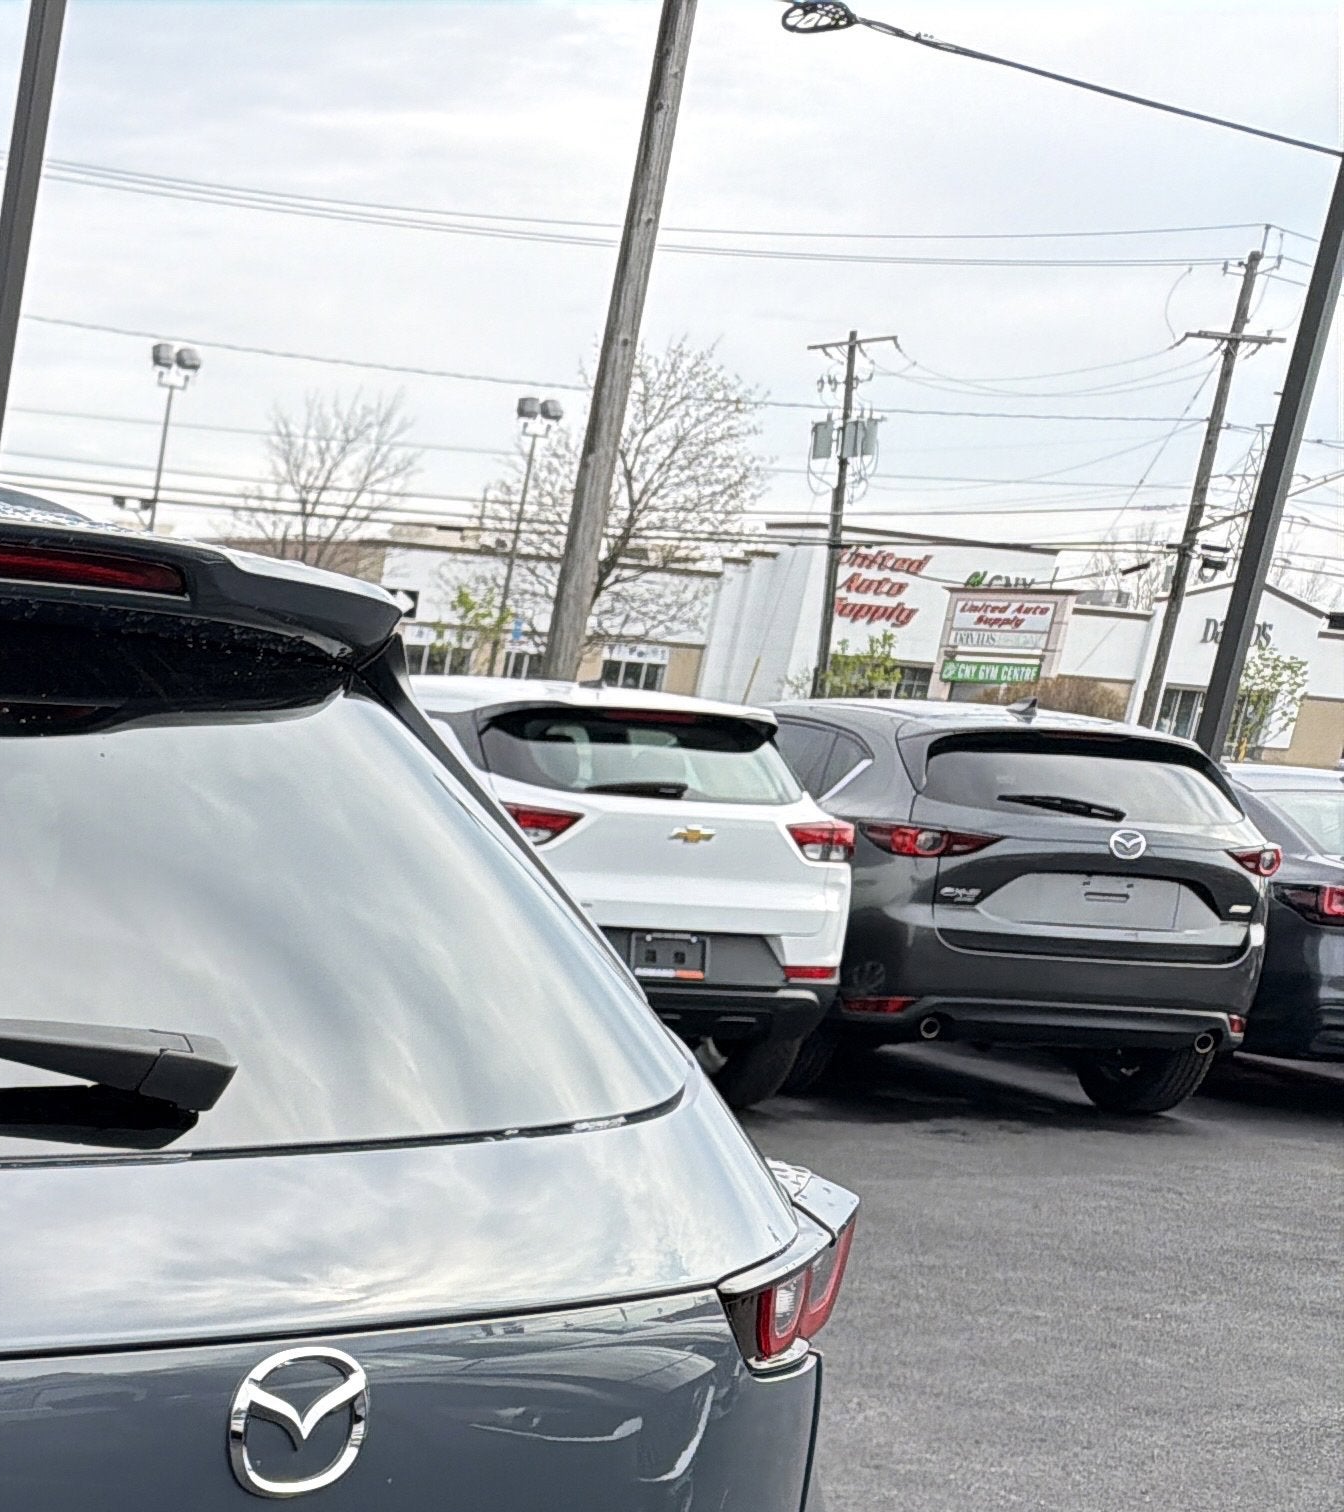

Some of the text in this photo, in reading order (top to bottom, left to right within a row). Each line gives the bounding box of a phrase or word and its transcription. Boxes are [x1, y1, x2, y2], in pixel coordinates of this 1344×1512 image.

[836, 572, 909, 597] Auto
[960, 601, 1051, 616] United Auto
[973, 614, 1026, 629] Supply
[957, 663, 977, 678] CNY
[979, 664, 999, 680] GYM
